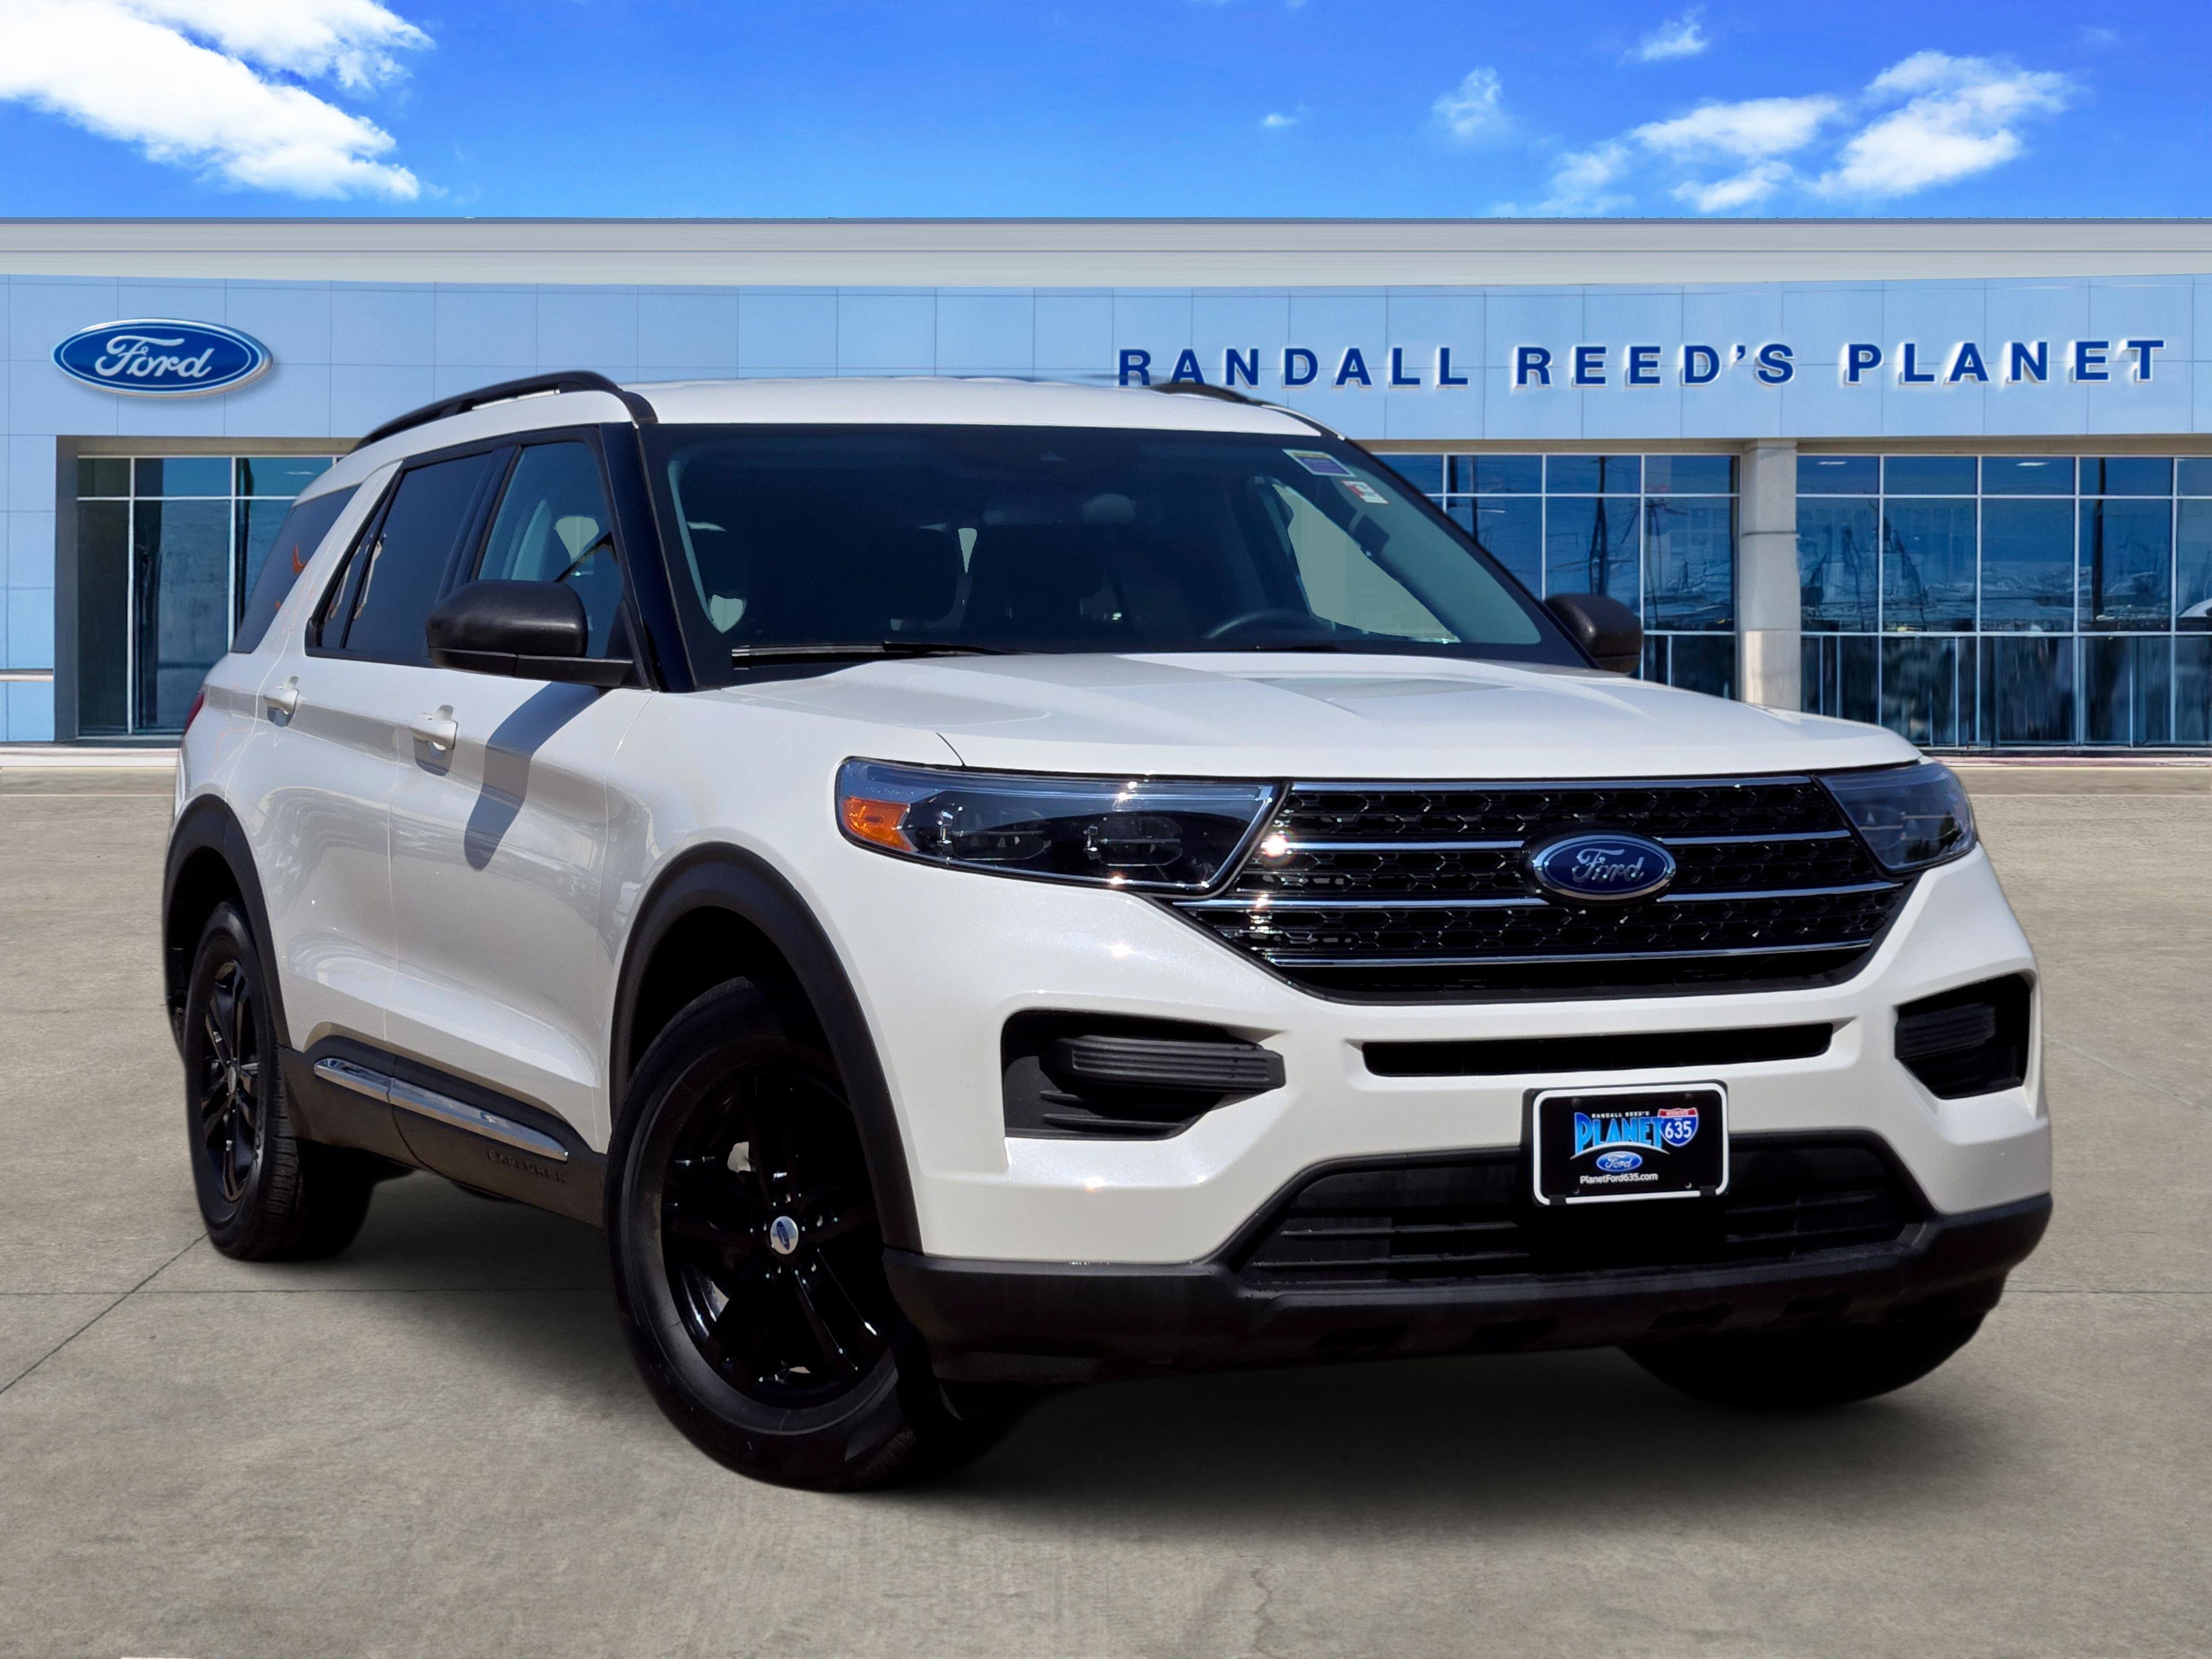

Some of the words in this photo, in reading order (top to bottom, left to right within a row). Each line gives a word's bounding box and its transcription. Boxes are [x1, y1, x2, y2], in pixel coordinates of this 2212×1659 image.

[95, 335, 215, 378] Ford
[1118, 347, 1469, 387] RANDALL
[1516, 344, 1796, 385] REED'S
[1847, 340, 2165, 384] PLANET
[1572, 848, 1645, 882] Ford
[1574, 1112, 1664, 1156] PLANET
[1665, 1120, 1693, 1140] 635
[1604, 1154, 1633, 1169] Ford
[1579, 1173, 1659, 1185] PlanetFord635.com
